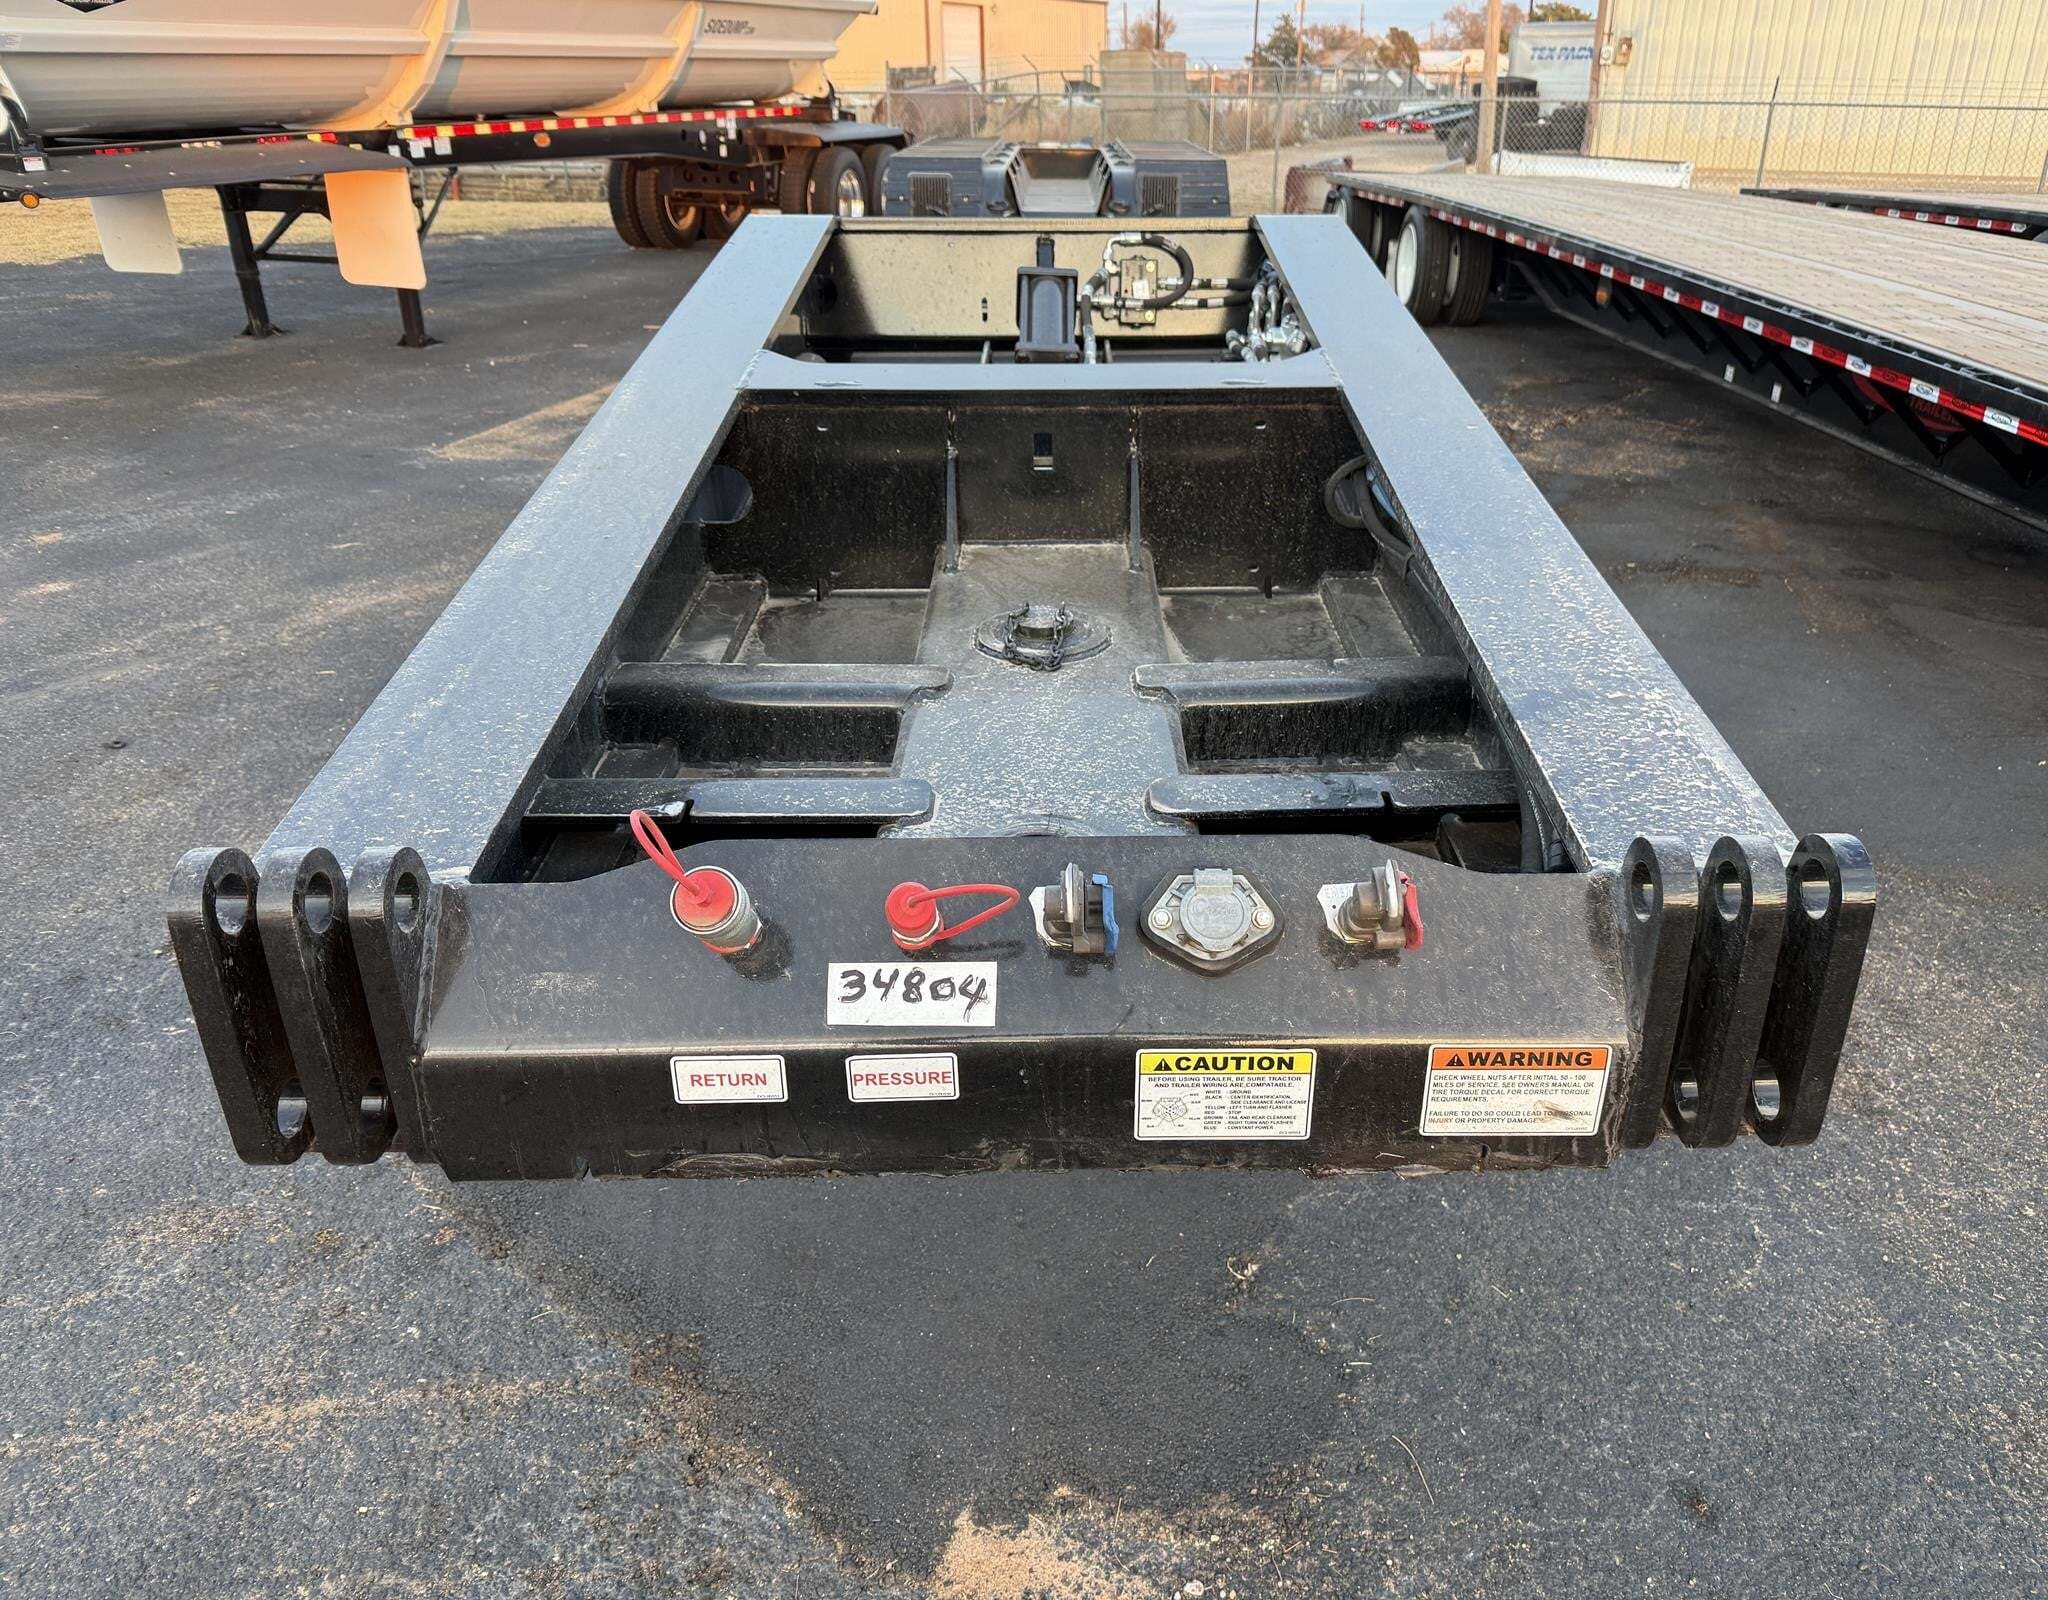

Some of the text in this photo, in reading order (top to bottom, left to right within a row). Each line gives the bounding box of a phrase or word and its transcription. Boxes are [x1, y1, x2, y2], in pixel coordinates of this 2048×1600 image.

[840, 966, 989, 1023] 34804
[1174, 1056, 1294, 1071] CAUTION
[1467, 1052, 1592, 1067] WARNING
[690, 1073, 767, 1087] RETURN
[853, 1071, 952, 1085] PRESSURE
